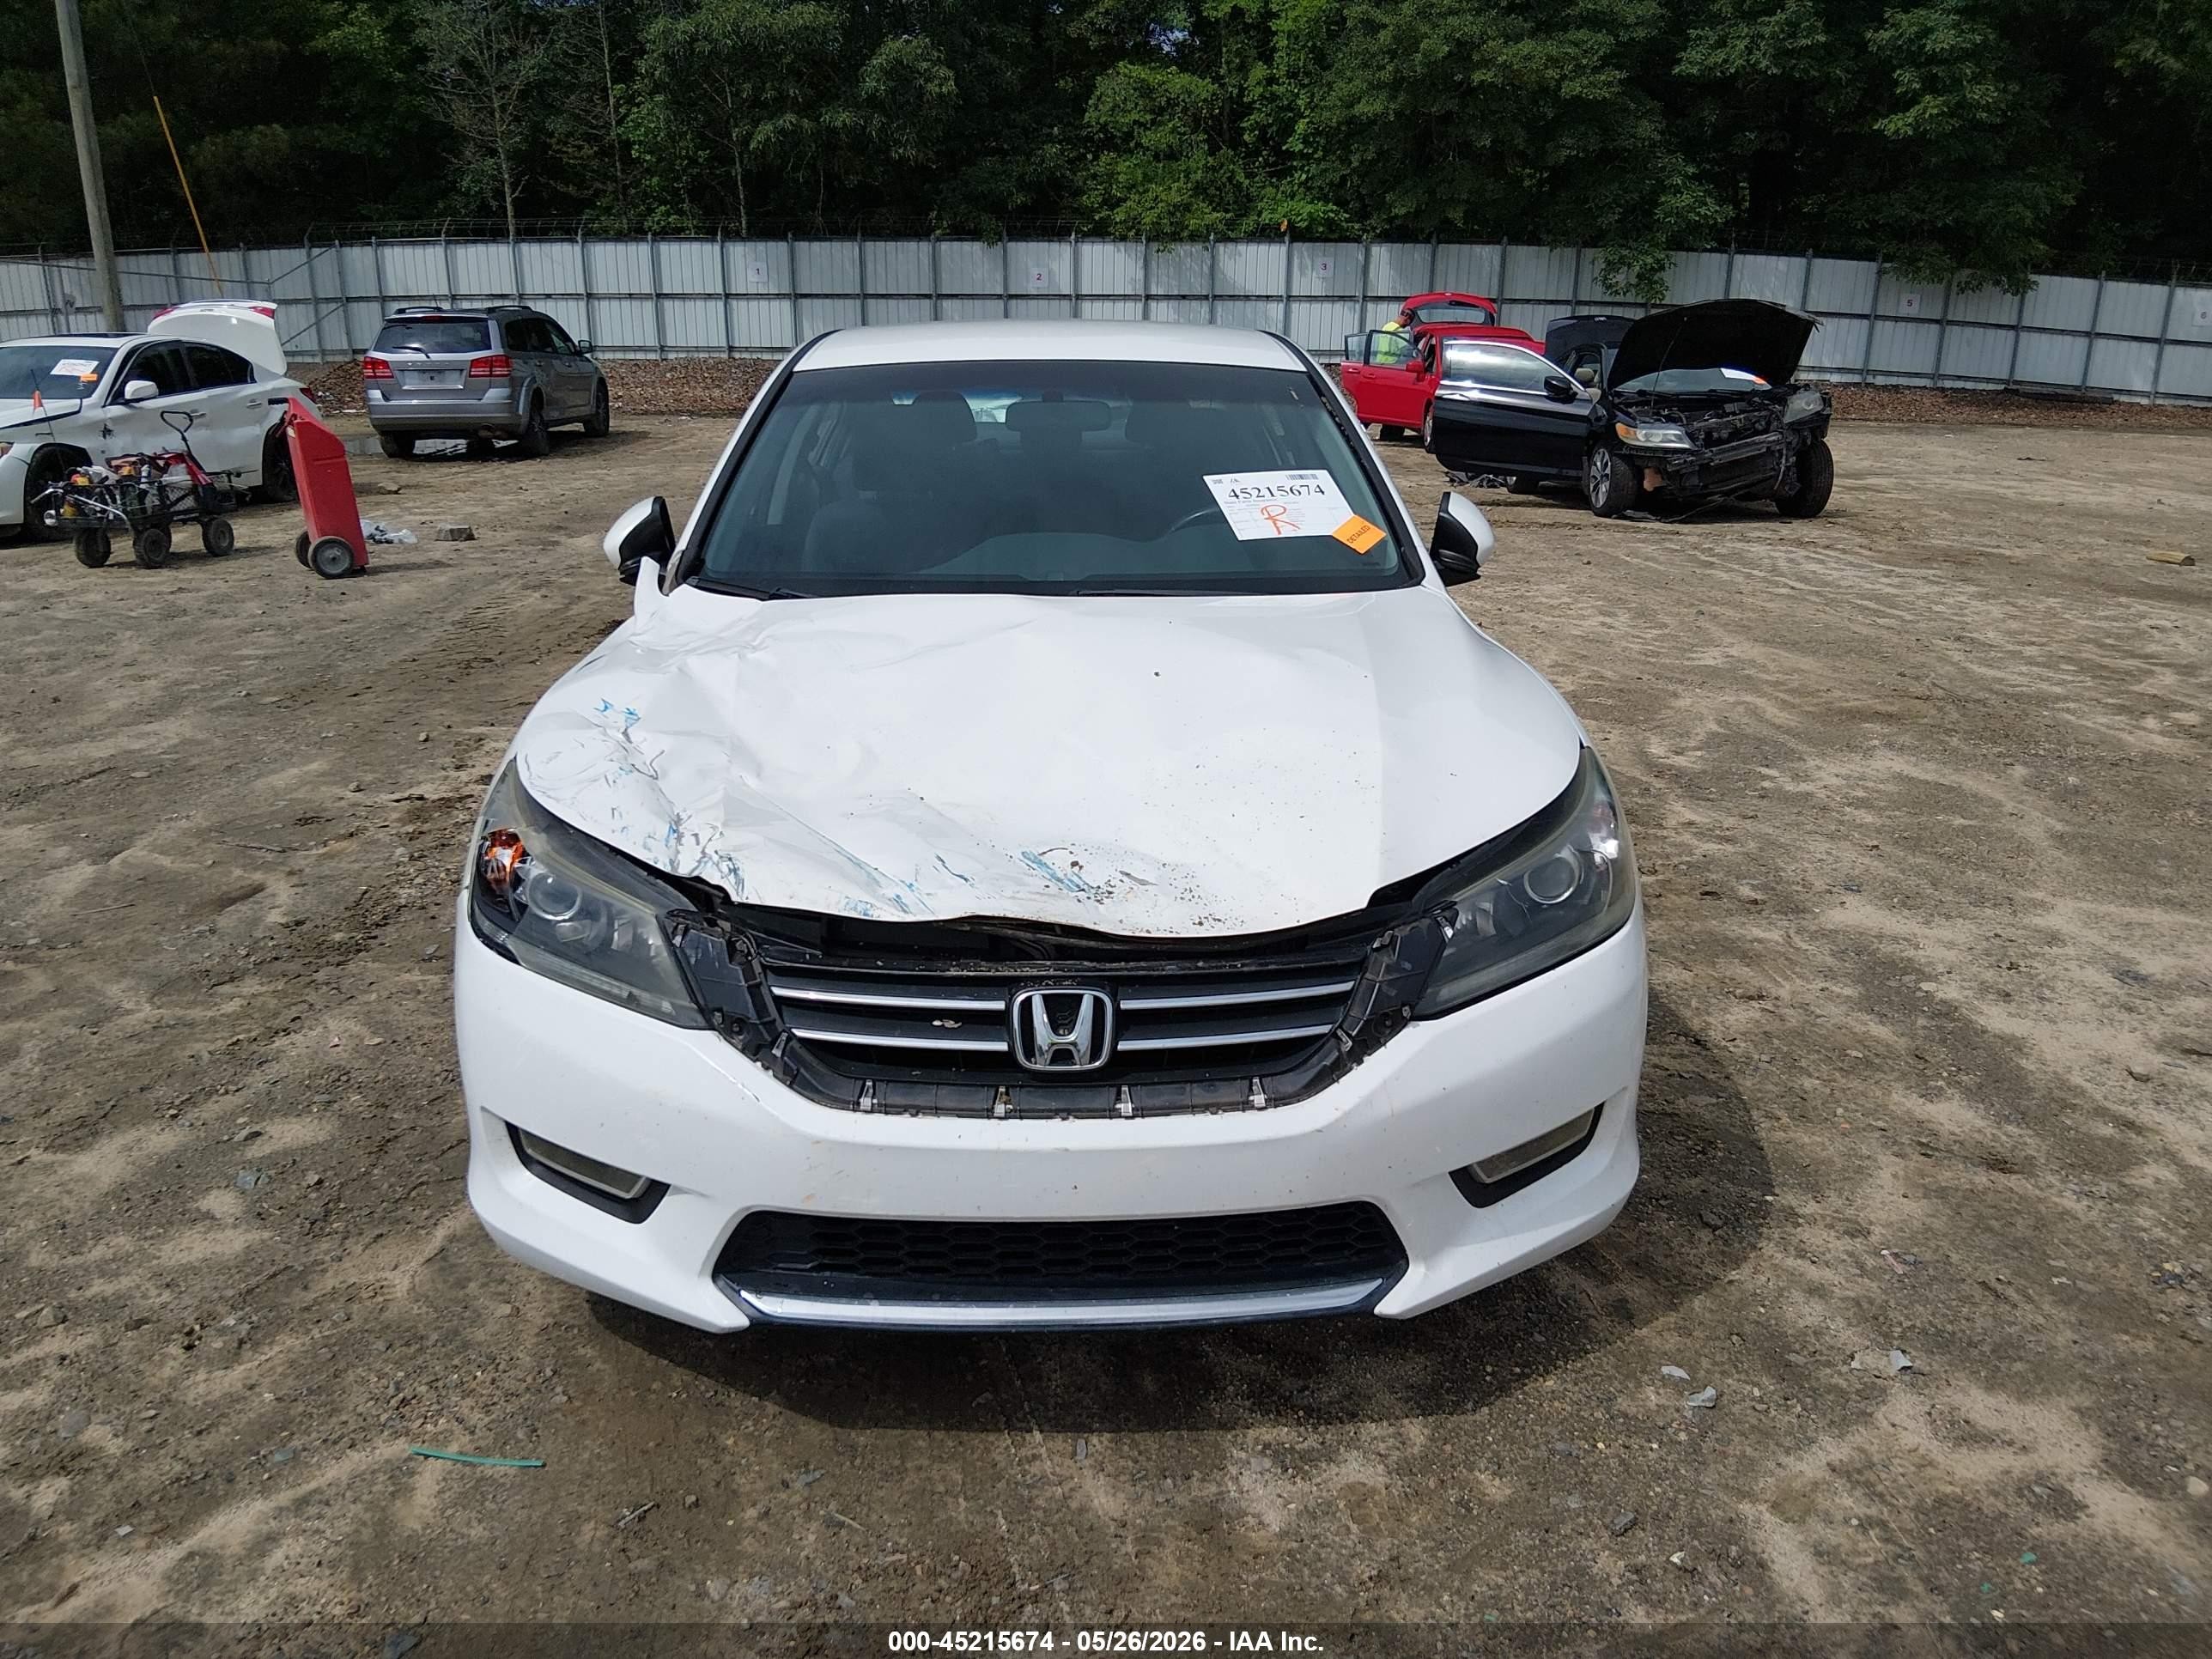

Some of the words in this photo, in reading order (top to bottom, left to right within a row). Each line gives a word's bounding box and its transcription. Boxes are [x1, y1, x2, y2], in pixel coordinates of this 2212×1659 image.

[1228, 483, 1325, 500] 45215674
[1261, 504, 1300, 535] R
[1346, 525, 1370, 544] DETAILED
